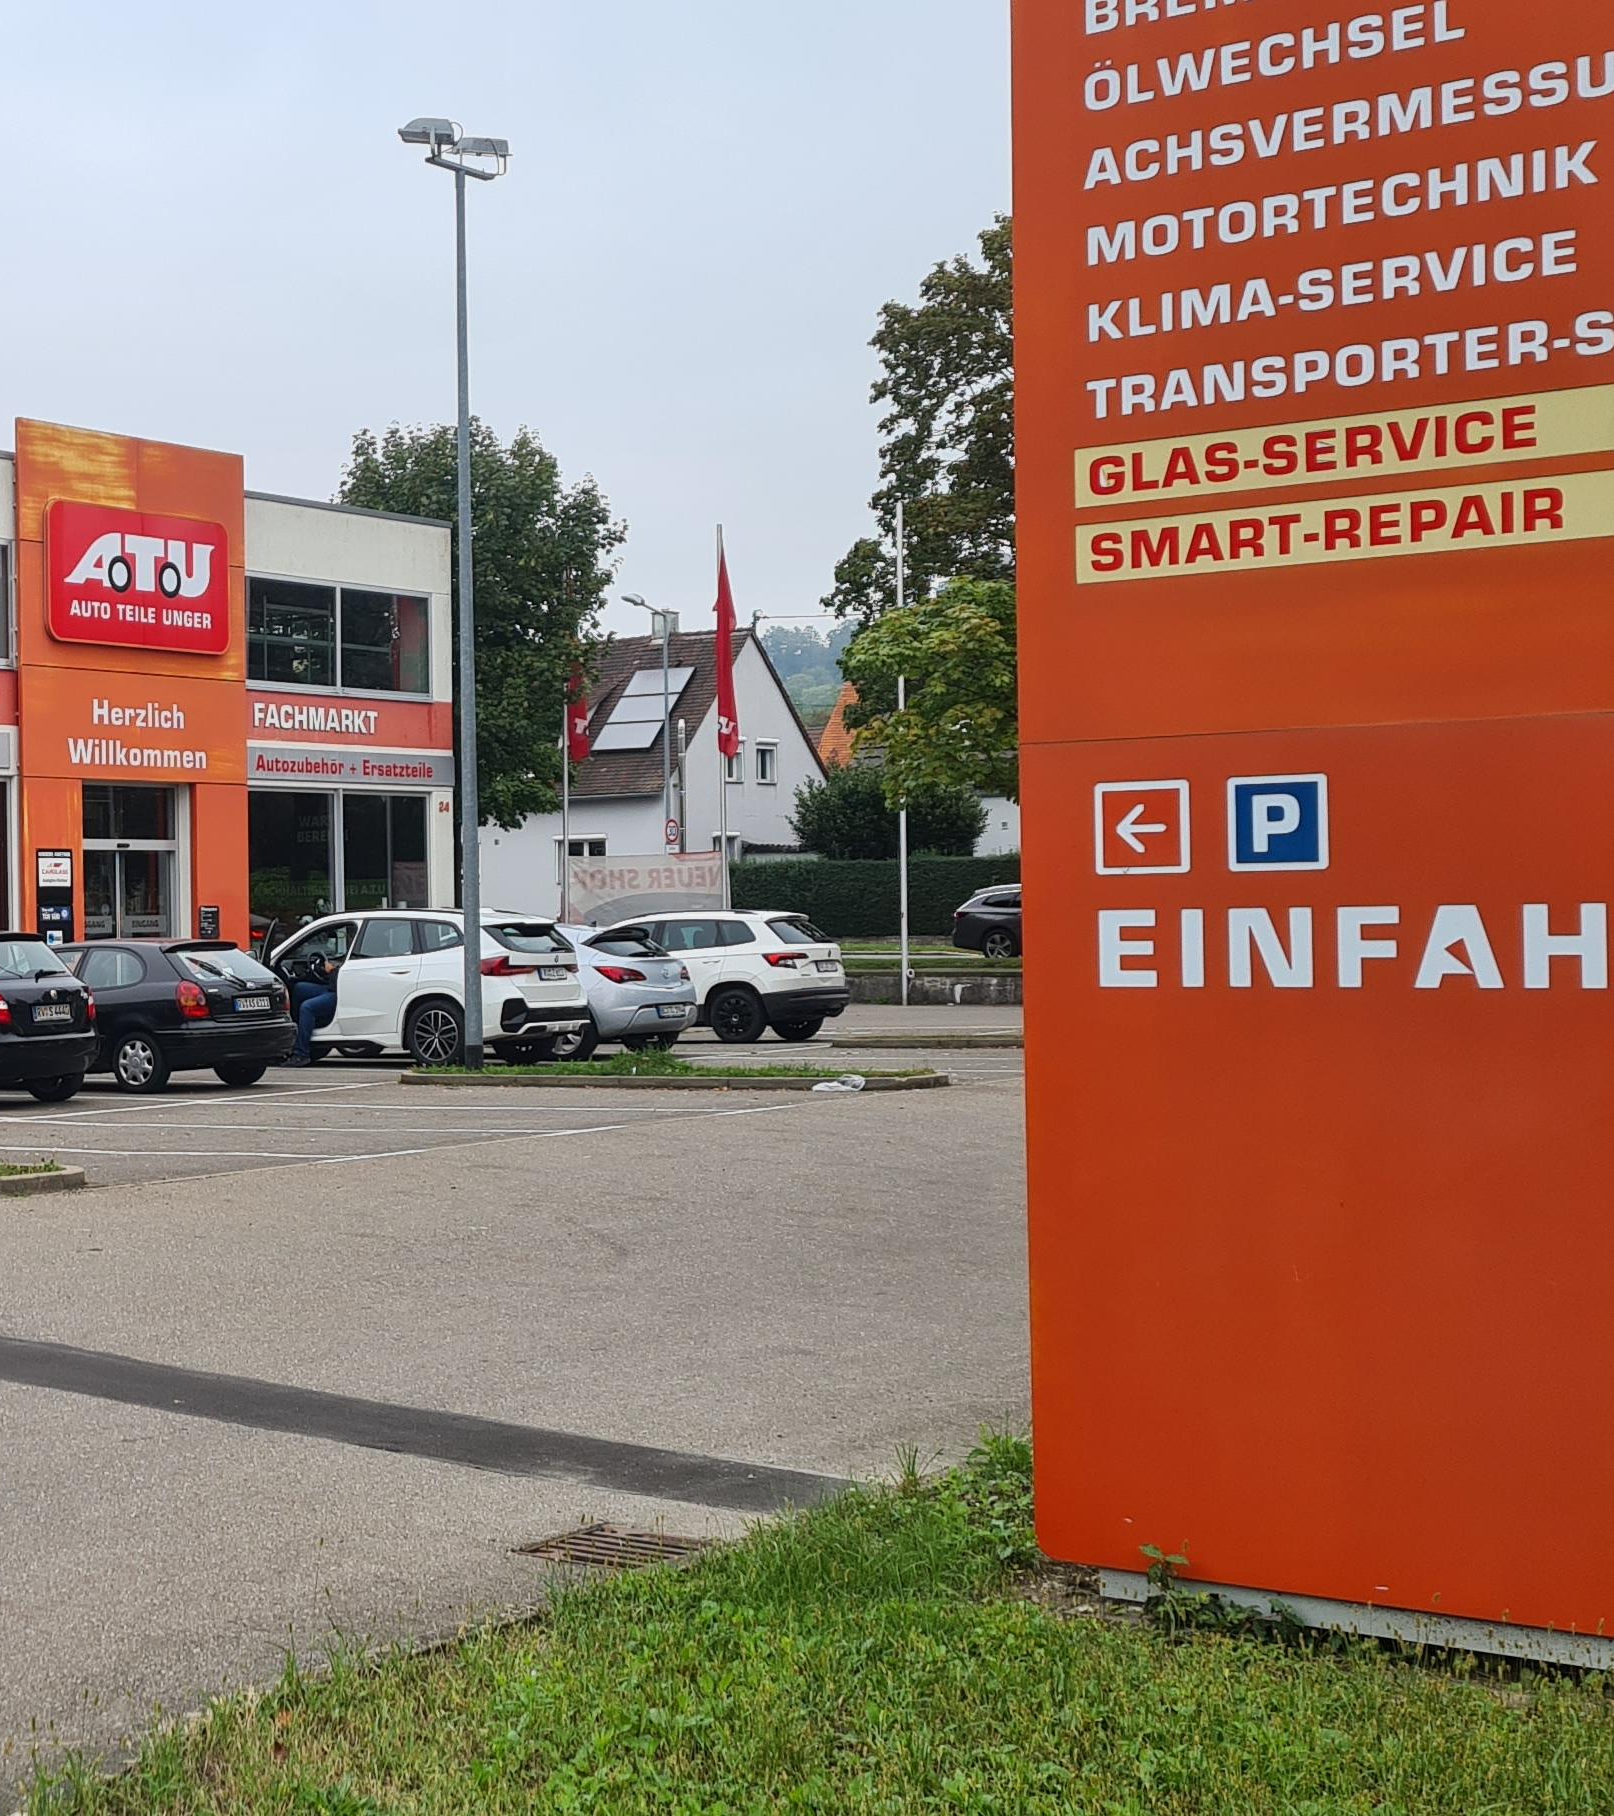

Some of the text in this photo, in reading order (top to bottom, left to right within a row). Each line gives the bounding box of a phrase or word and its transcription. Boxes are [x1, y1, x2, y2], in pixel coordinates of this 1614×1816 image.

[1083, 0, 1466, 111] ÖLWECHSEL
[1086, 140, 1599, 267] MOTORTECHNIK
[1088, 229, 1577, 343] KLIMA-SERVICE
[1086, 310, 1614, 419] TRANSPORTER-S
[1089, 405, 1538, 496] GLAS-SERVICE
[1089, 487, 1565, 572] SMART-REPAIR
[70, 599, 212, 630] AUTO TEILE UNGER
[92, 698, 185, 730] Herzlich
[252, 702, 379, 735] FACHMARKT
[67, 736, 208, 770] Willkommen
[255, 753, 345, 776] Autozubehör
[362, 759, 434, 779] Ersatzteile
[438, 800, 451, 813] 24
[1251, 793, 1301, 854] P
[1097, 902, 1609, 989] EINFAH
